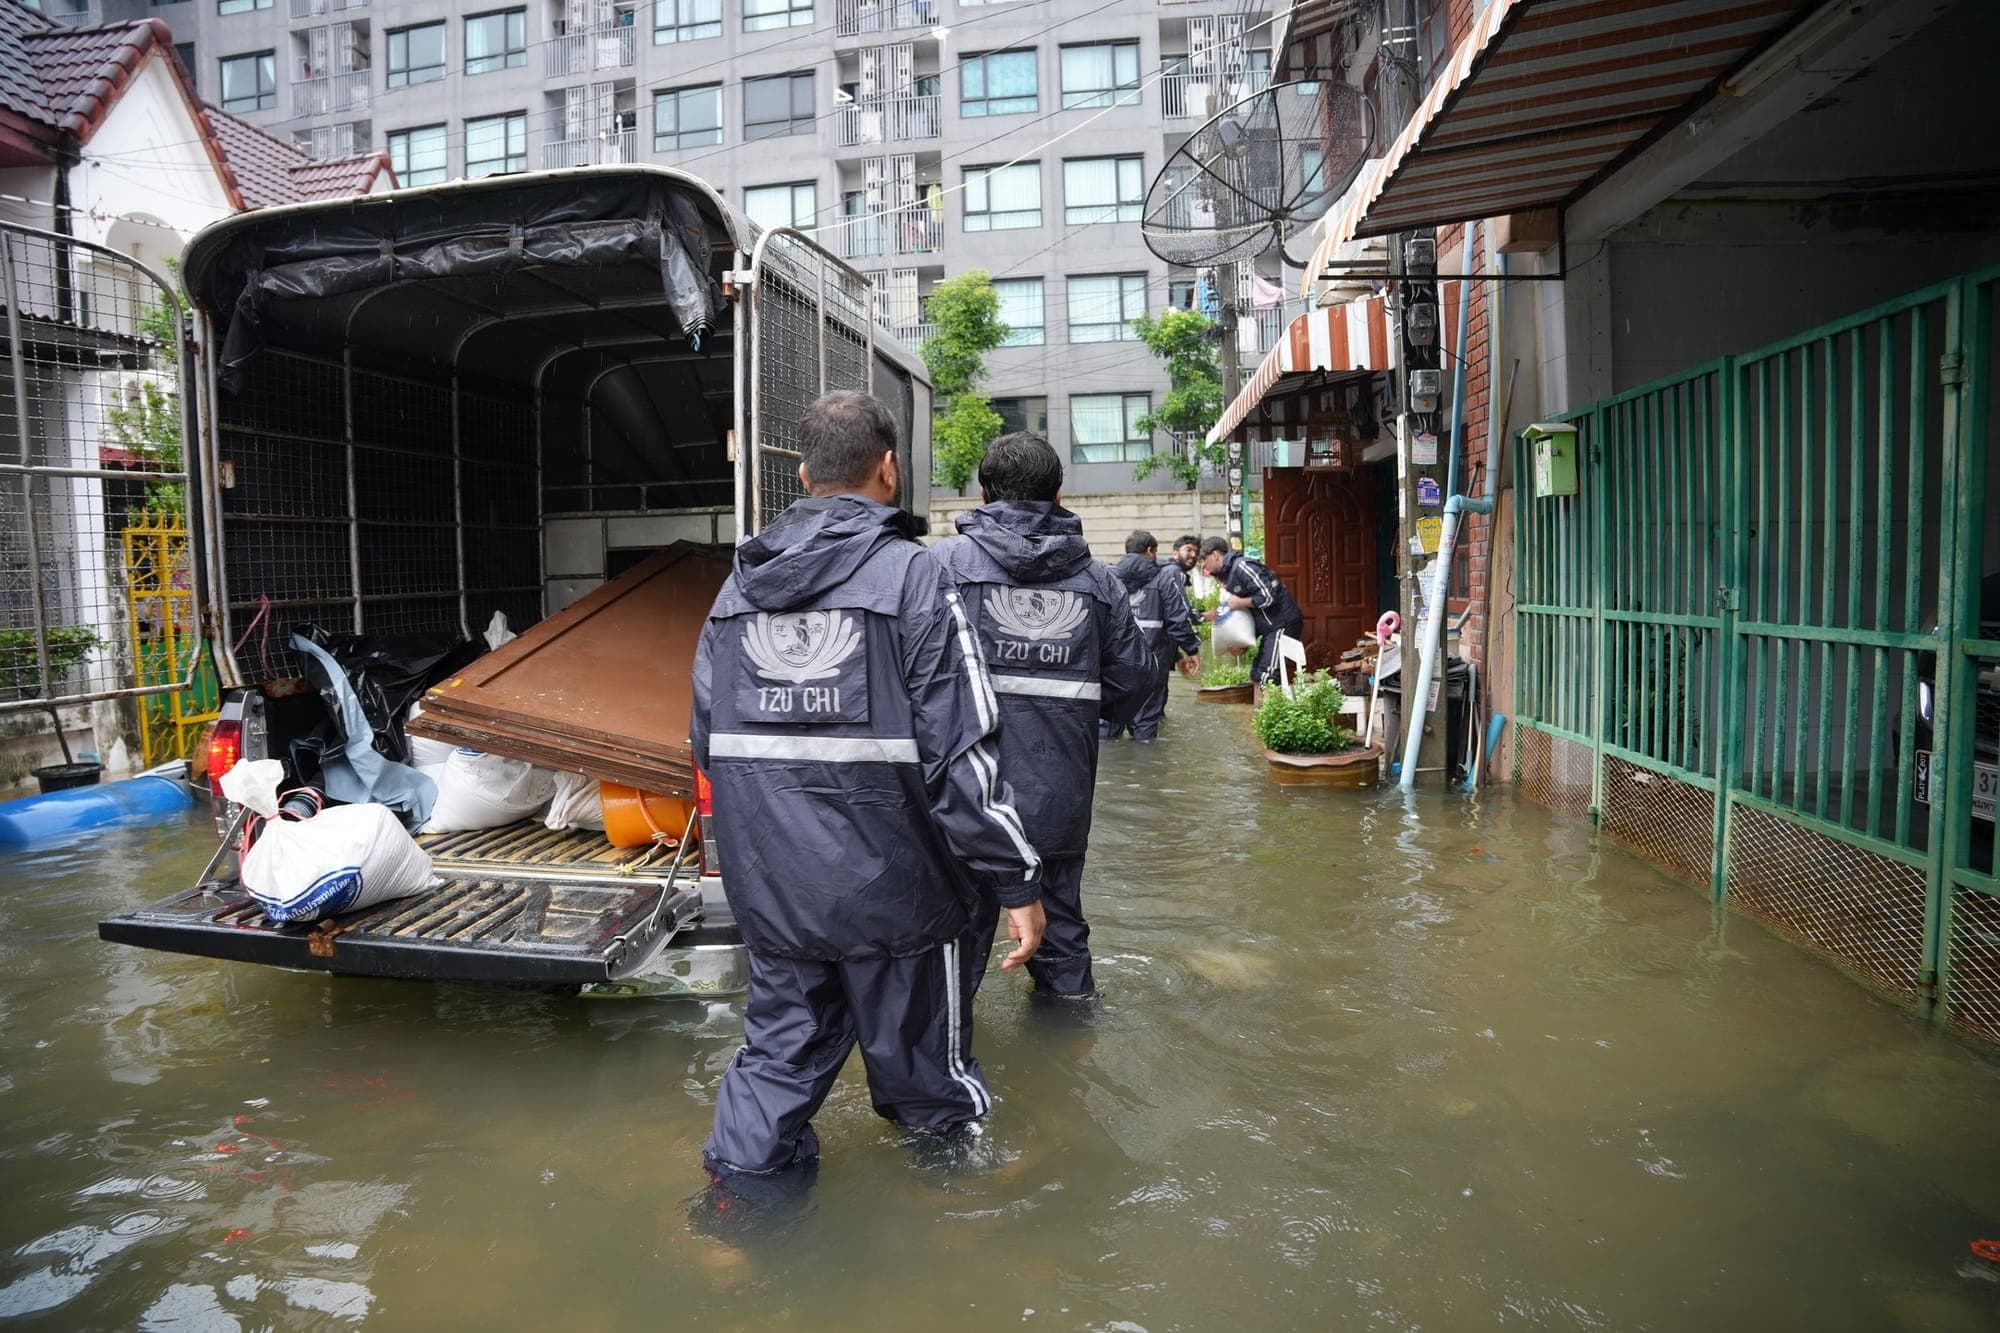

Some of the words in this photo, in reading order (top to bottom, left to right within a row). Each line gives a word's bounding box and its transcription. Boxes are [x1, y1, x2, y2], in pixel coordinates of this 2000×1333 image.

[995, 640, 1029, 660] TZU
[1039, 643, 1071, 664] CHI
[757, 686, 793, 712] TZU
[803, 687, 841, 712] CHI
